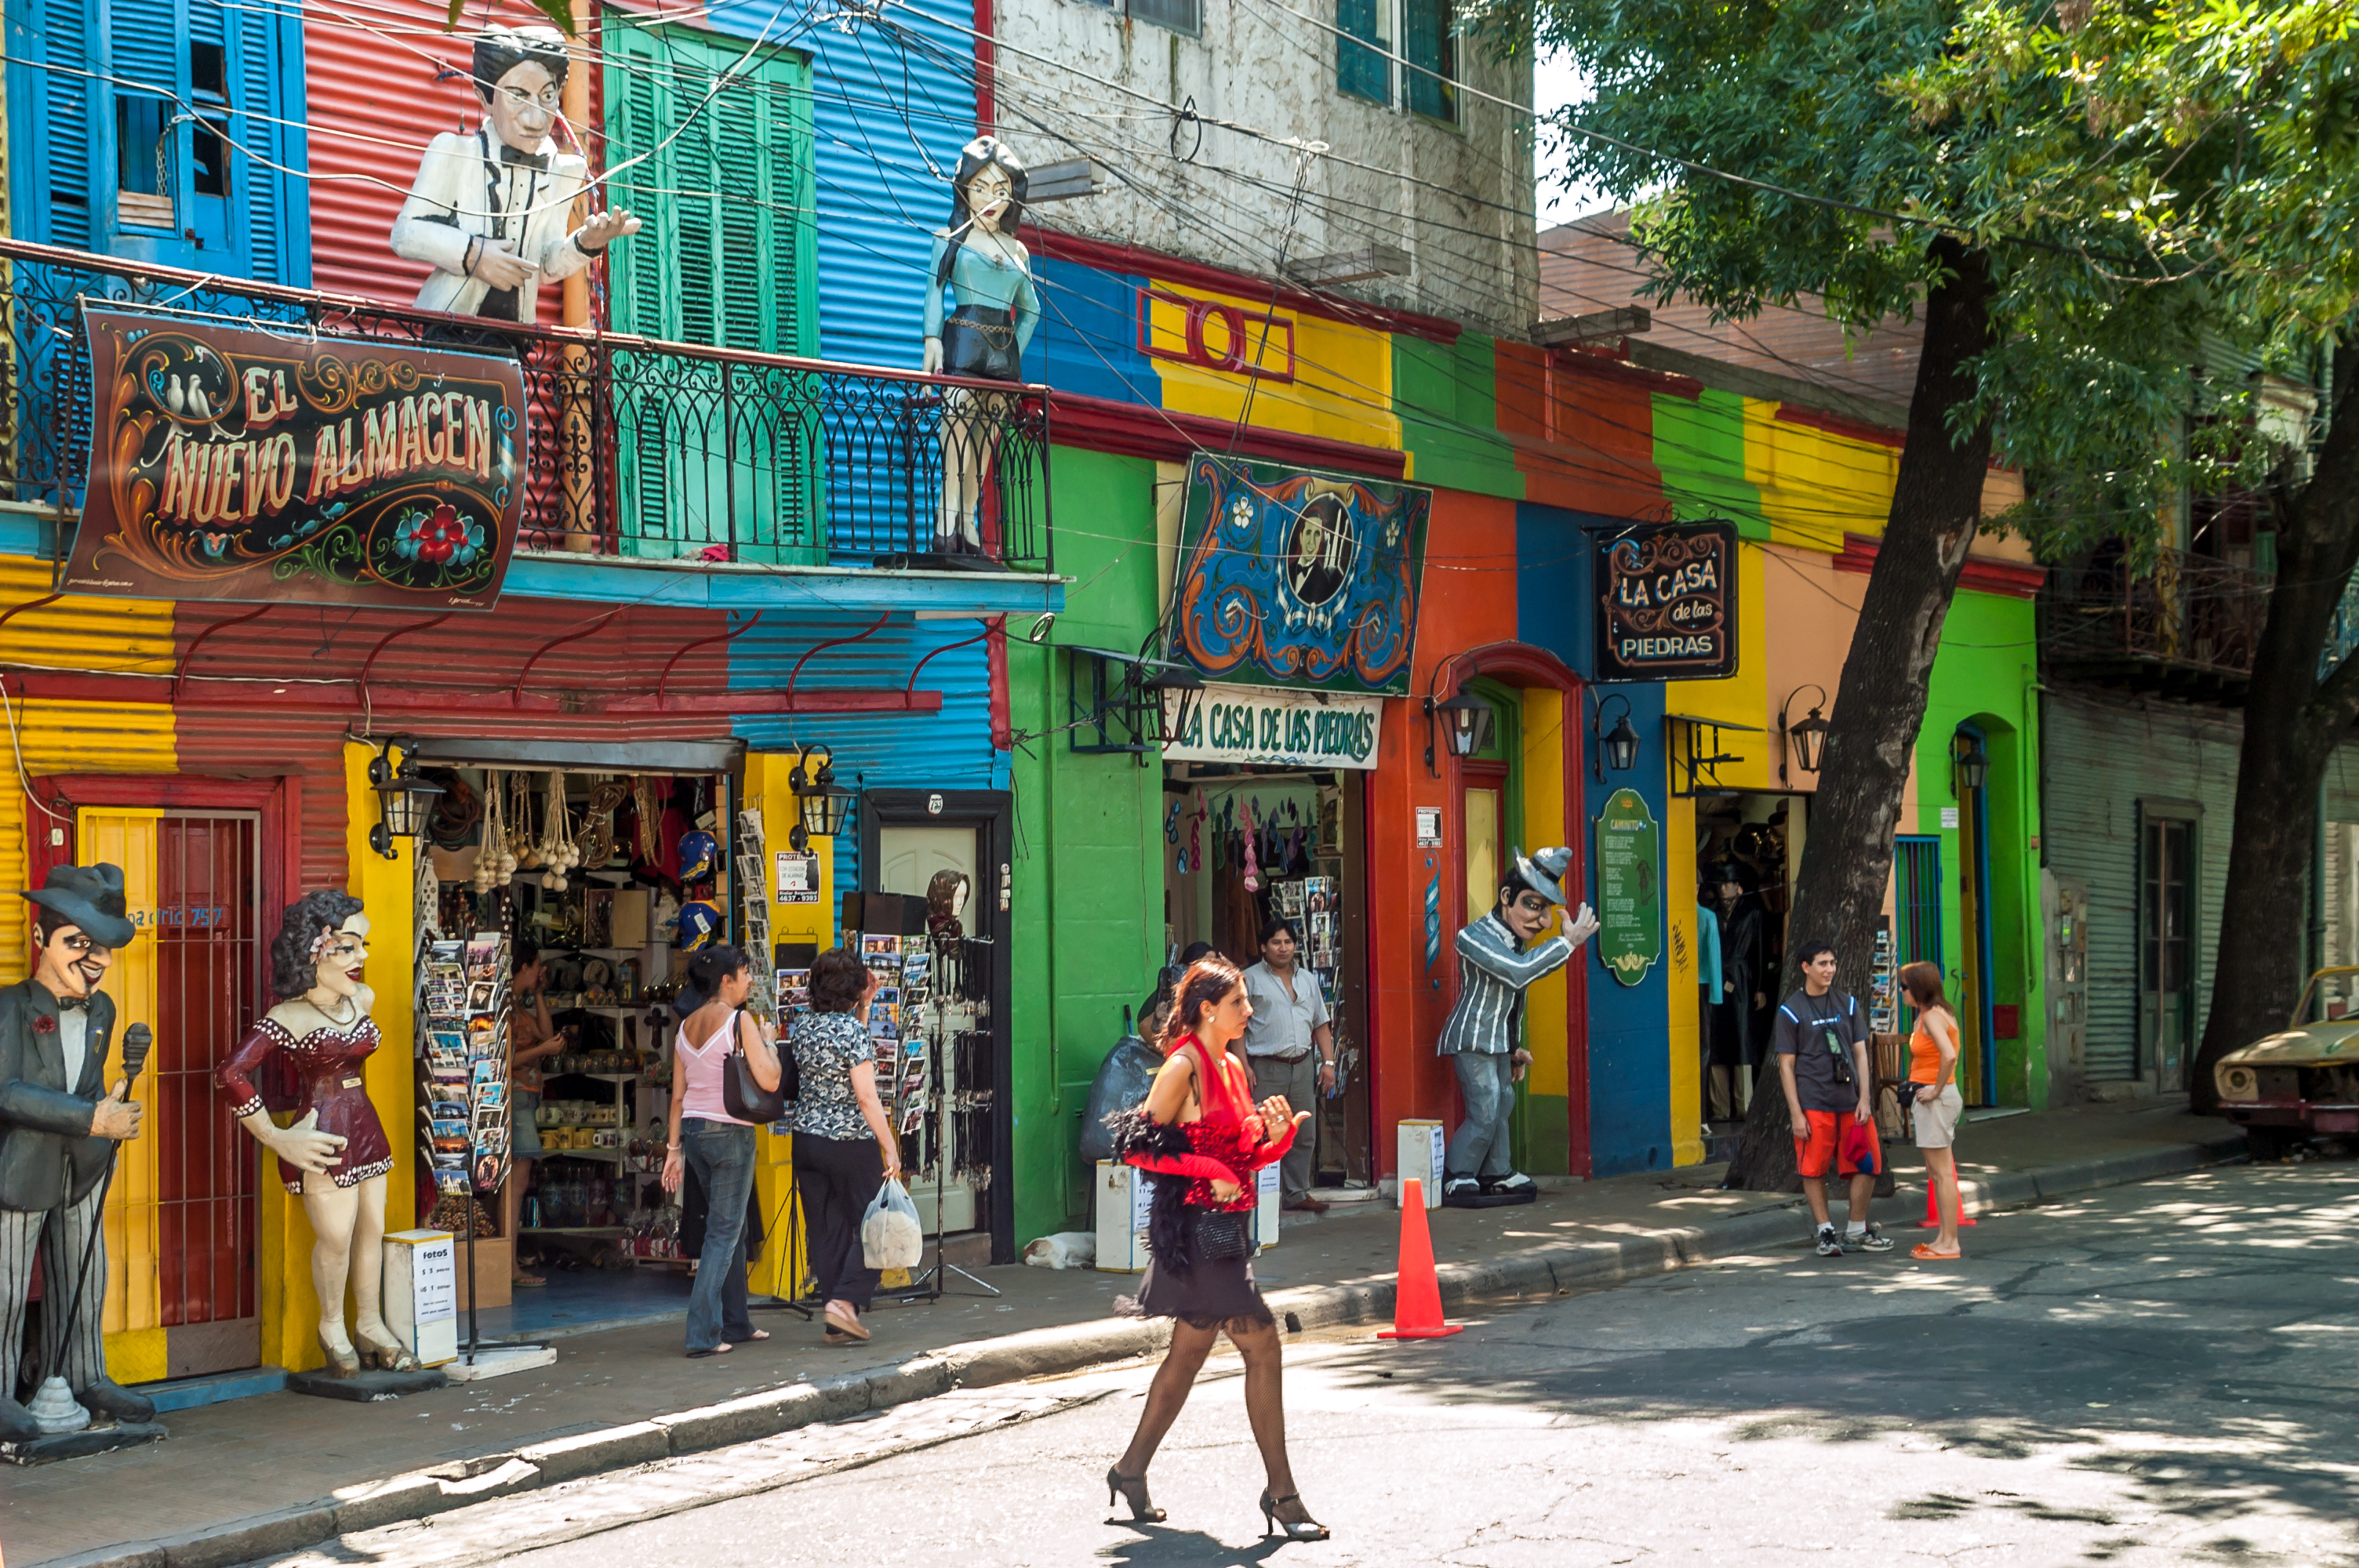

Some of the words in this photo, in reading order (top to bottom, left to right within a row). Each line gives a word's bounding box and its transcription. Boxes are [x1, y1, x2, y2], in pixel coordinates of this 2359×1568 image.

[242, 367, 298, 430] EL
[158, 432, 296, 525] NUEVO
[306, 392, 491, 505] ALMACEN
[1620, 577, 1649, 606] LA
[1656, 560, 1717, 603] CASA
[1673, 602, 1690, 621] de
[1692, 600, 1713, 618] las
[1622, 636, 1713, 658] PIEDRAS
[1209, 702, 1254, 750] CASA
[1259, 707, 1282, 751] DE
[1285, 706, 1311, 753] LAS
[1314, 706, 1375, 763] PIEDRAS
[1610, 819, 1639, 831] CAMINITO
[191, 909, 222, 926] 757
